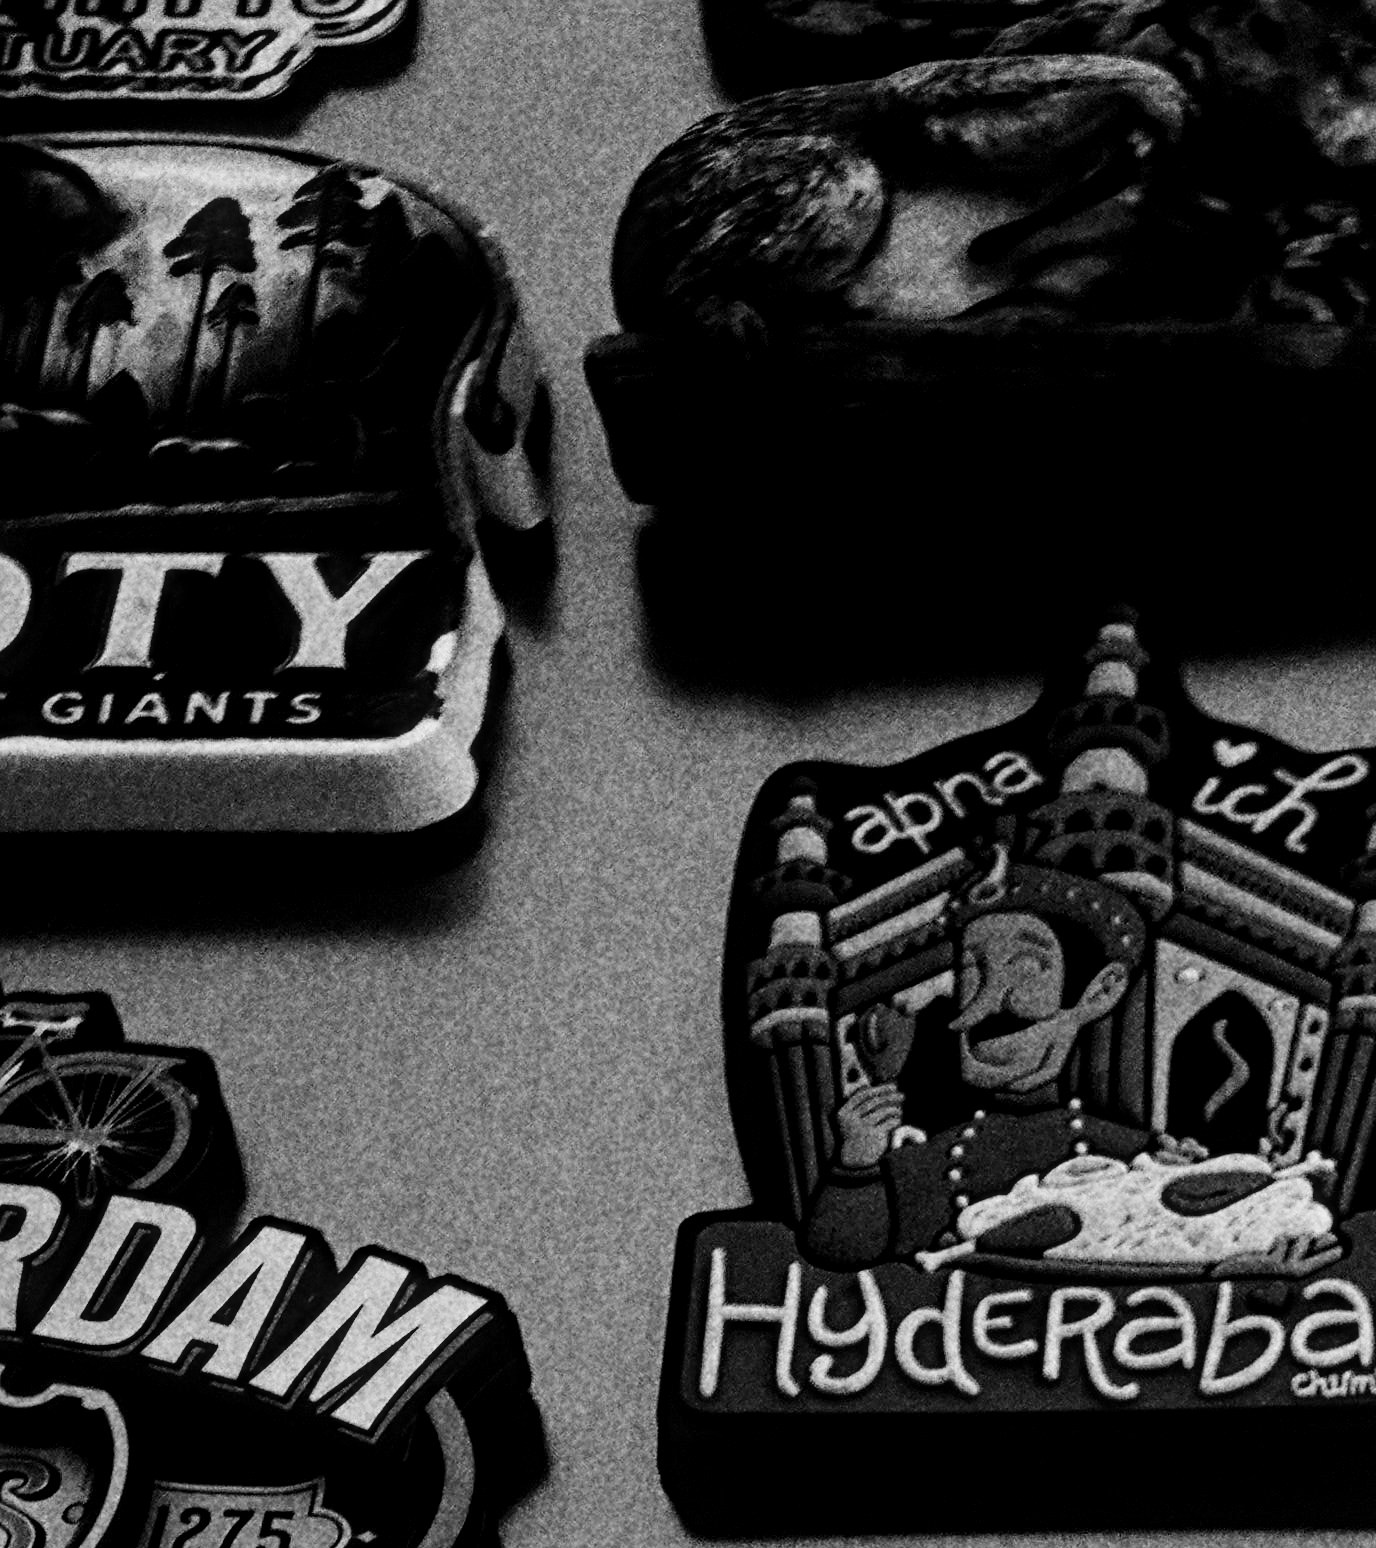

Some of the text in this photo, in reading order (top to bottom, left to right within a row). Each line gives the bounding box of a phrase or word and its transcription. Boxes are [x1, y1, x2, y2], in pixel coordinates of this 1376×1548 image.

[0, 550, 430, 670] TY
[41, 690, 323, 725] GIANTS
[842, 750, 1043, 855] apna
